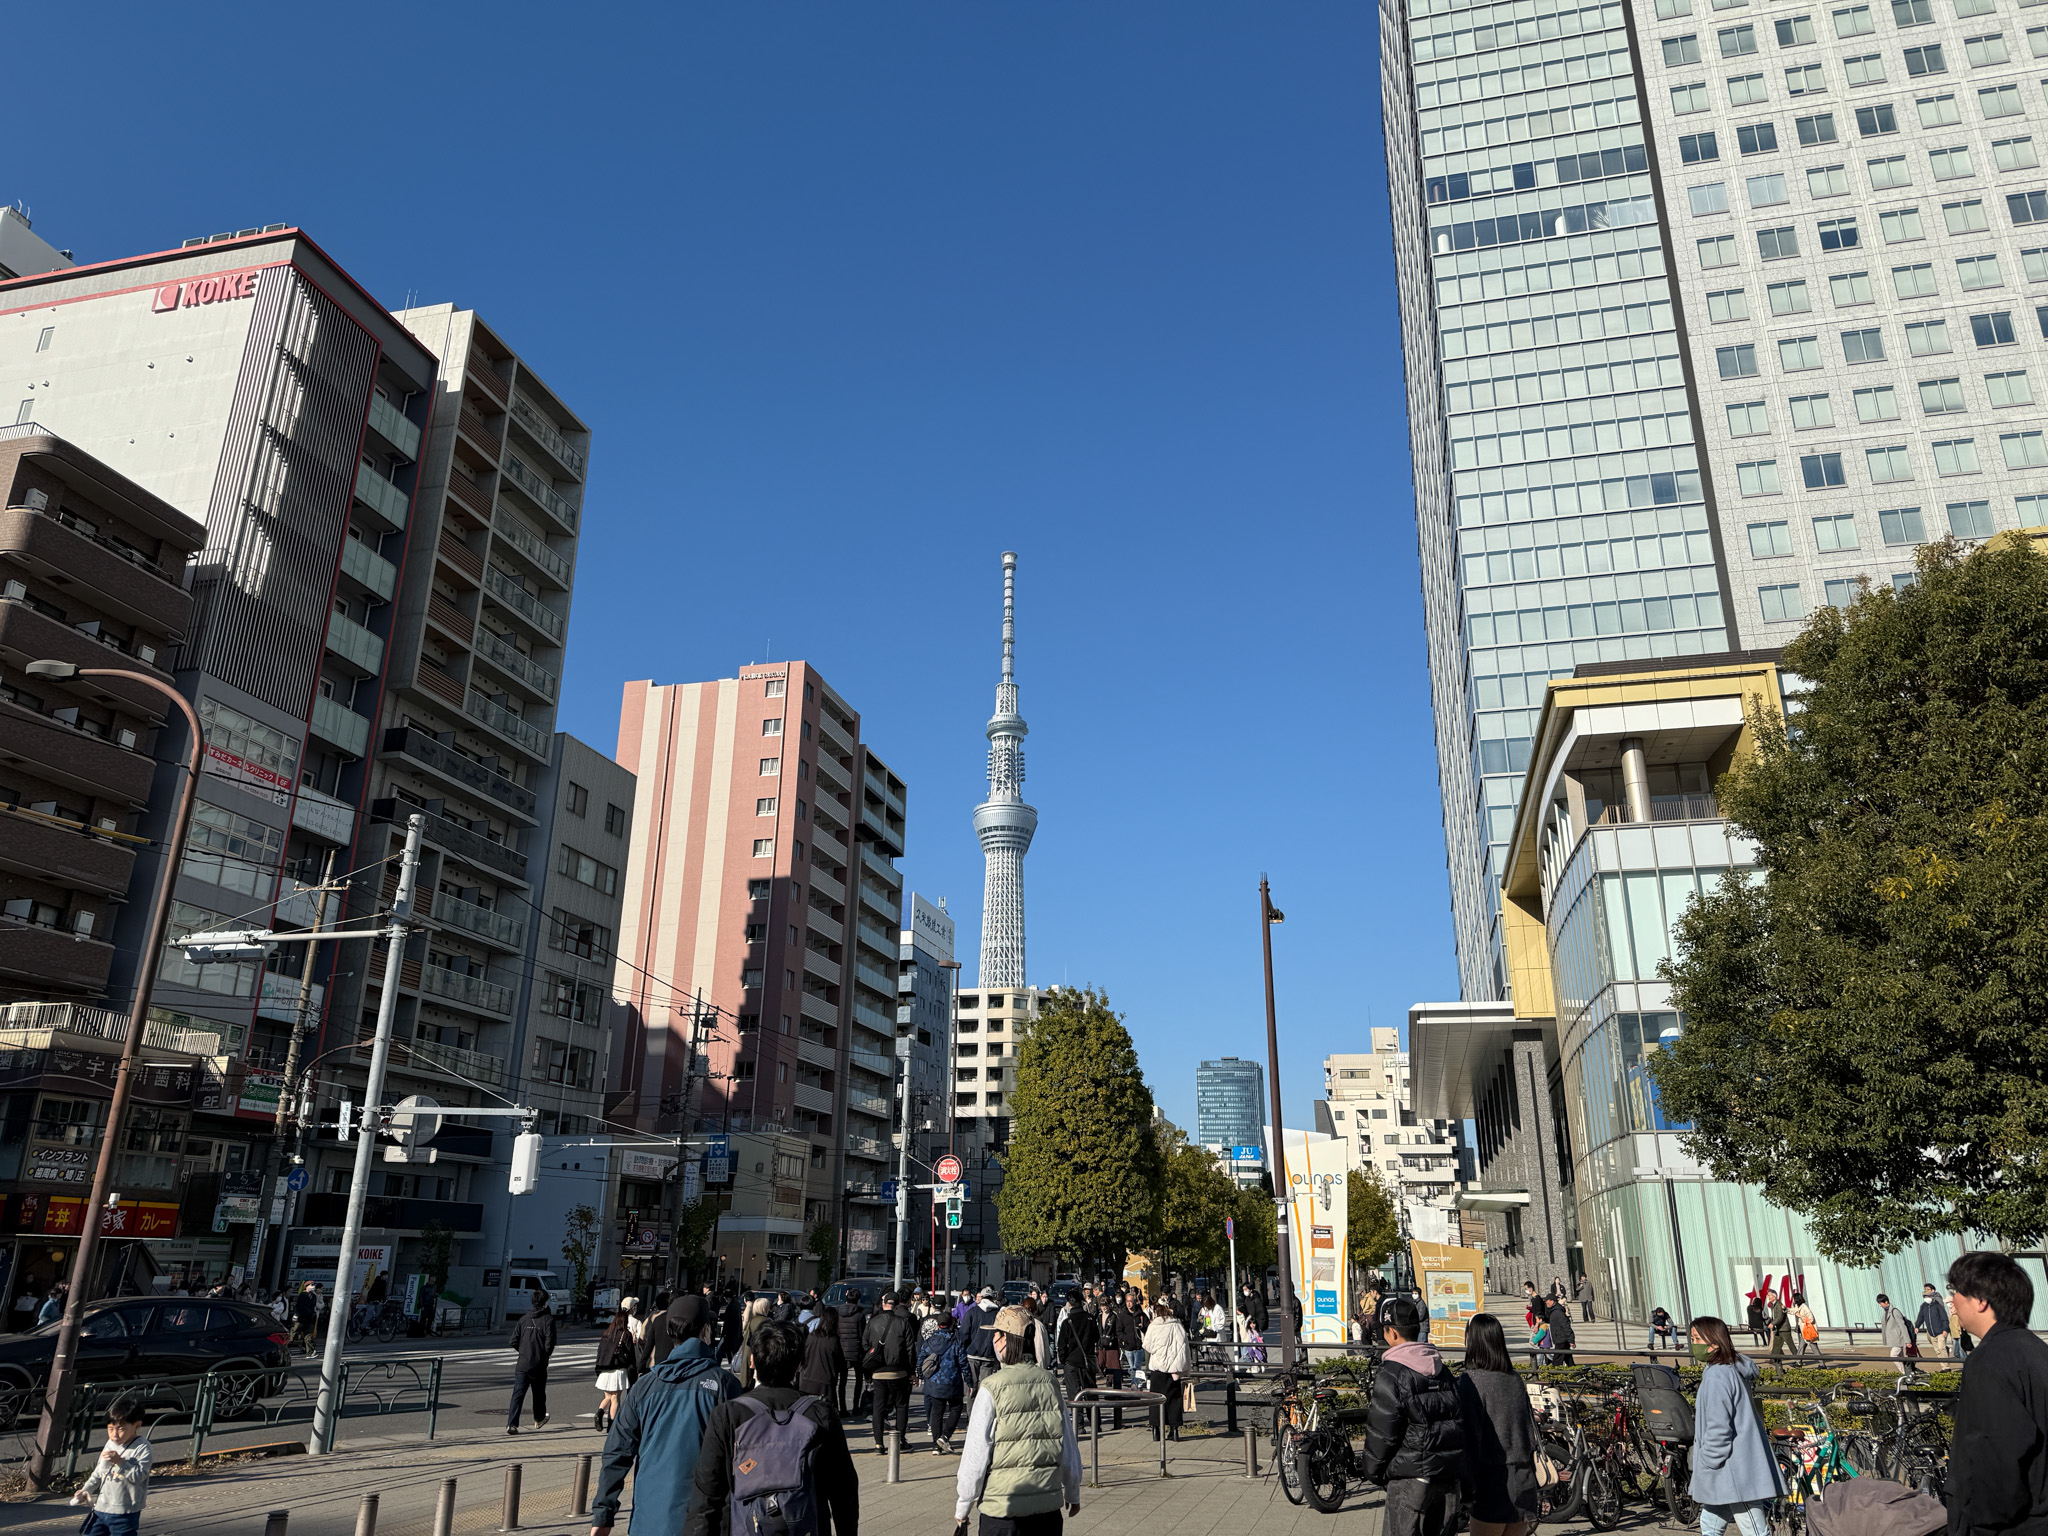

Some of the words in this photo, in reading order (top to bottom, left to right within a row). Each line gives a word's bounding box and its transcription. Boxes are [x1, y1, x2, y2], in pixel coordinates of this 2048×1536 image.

[182, 271, 257, 307] KOIKE
[202, 1095, 219, 1107] 2F
[39, 1148, 89, 1164] インプラント
[1240, 1147, 1253, 1155] JU
[940, 1166, 957, 1175] 消火栓
[139, 1211, 171, 1231] カレー
[357, 1248, 384, 1260] KOIKE
[405, 1276, 417, 1313] FamilyMart
[1744, 1273, 1804, 1309] HM
